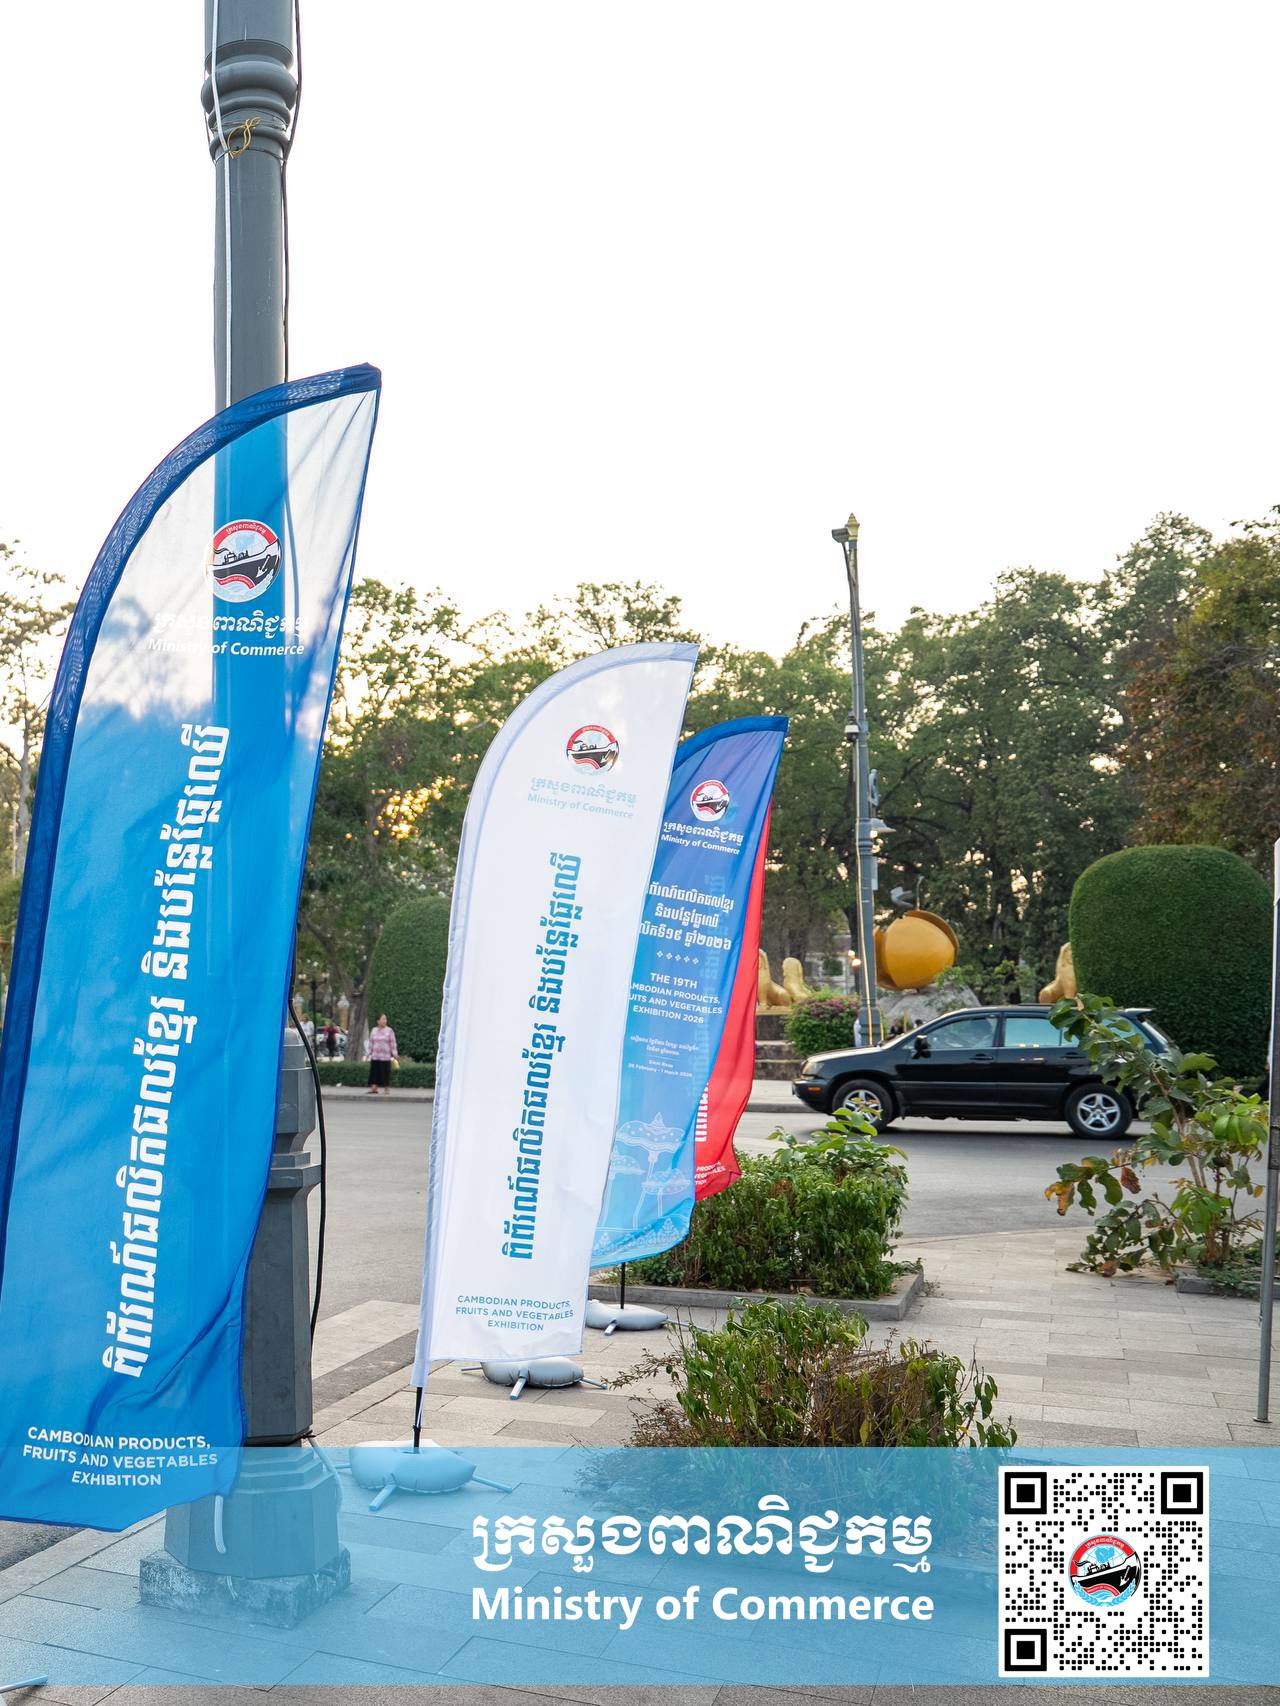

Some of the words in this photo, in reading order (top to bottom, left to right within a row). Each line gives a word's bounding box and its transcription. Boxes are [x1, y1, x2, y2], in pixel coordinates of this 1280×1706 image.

[212, 641, 228, 655] of
[231, 643, 305, 656] Commerce
[528, 793, 567, 809] Ministry
[582, 803, 634, 819] Commerce
[661, 834, 690, 848] Ministry
[692, 840, 701, 848] of
[650, 972, 671, 984] THE
[673, 977, 698, 989] 19TH
[629, 983, 672, 996] MBODIAN
[673, 990, 721, 1005] PRODUCTS,
[628, 994, 647, 1003] UITS
[648, 997, 668, 1006] AND
[670, 1000, 723, 1014] VEGETABLES
[633, 1005, 681, 1020] EXHIBITION
[683, 1014, 705, 1024] 2026
[458, 1296, 518, 1306] CAMBODIAN
[456, 1307, 489, 1316] FRUITS
[492, 1309, 512, 1317] AND
[516, 1309, 574, 1321] VEGETABLES
[487, 1320, 544, 1331] EXHIBITION
[28, 1427, 114, 1449] CAMBODIAN
[119, 1436, 211, 1449] PRODUCTS,
[23, 1445, 76, 1463] FRUITS
[80, 1453, 109, 1467] AND
[113, 1454, 218, 1469] VEGETABLES
[71, 1471, 161, 1486] EXHIBITION
